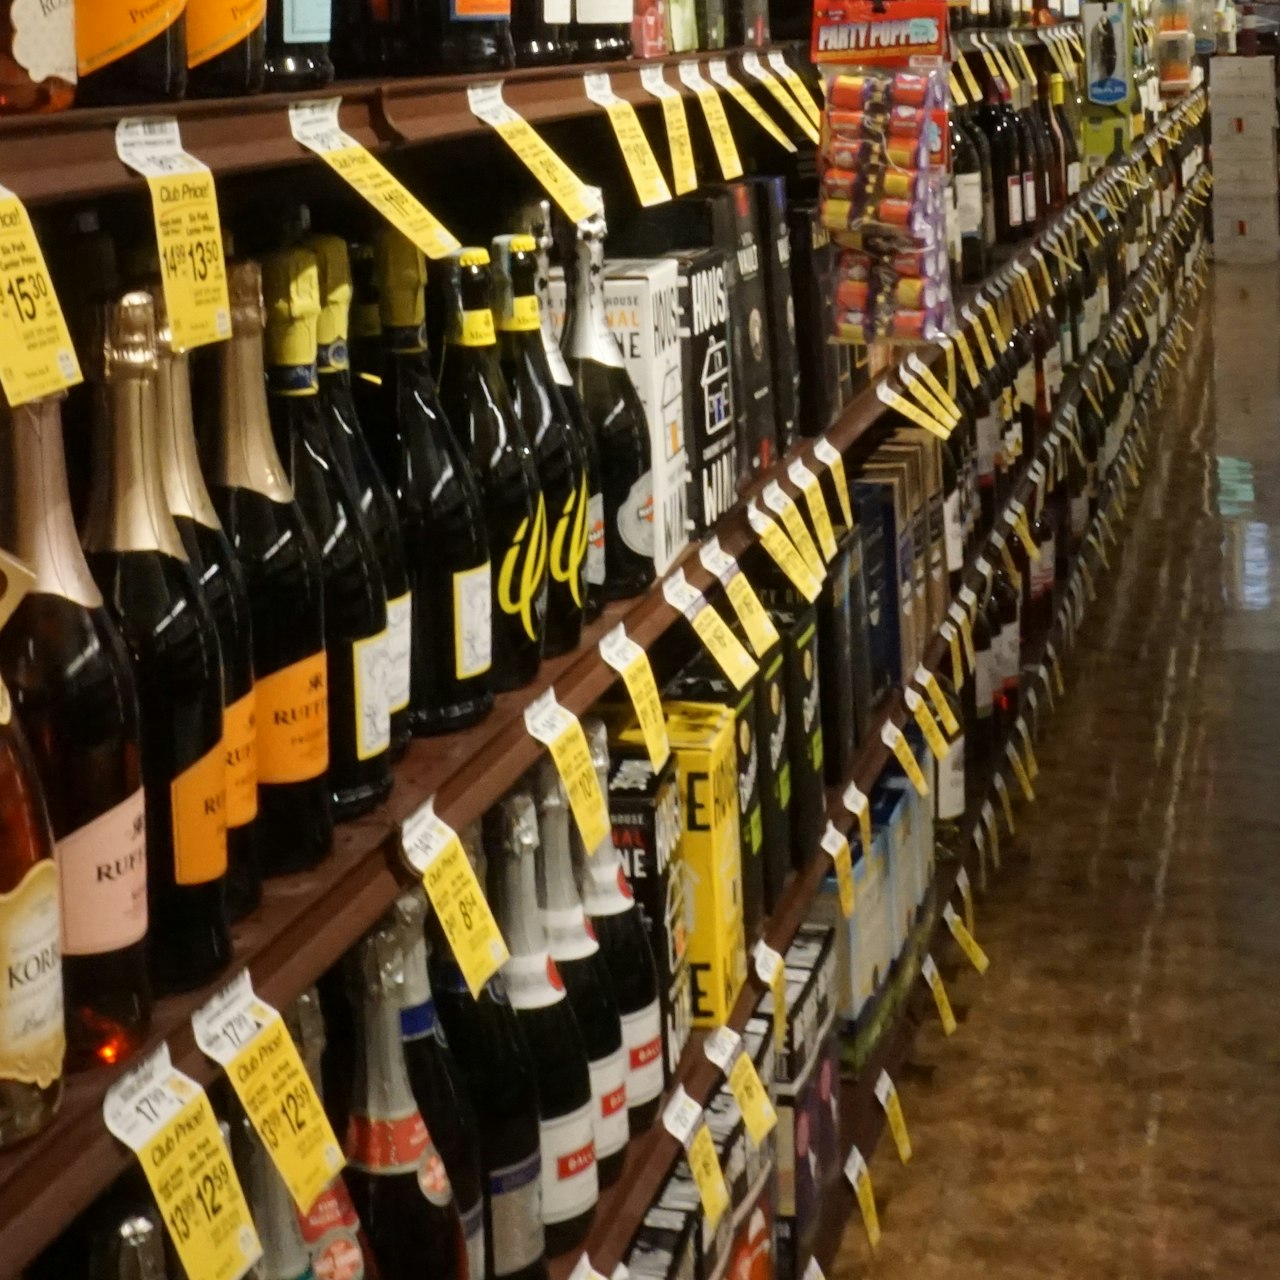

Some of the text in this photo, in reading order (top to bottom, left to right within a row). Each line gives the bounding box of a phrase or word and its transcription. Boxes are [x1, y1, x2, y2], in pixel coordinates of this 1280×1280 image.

[818, 22, 868, 51] PARTY
[159, 179, 211, 203] Club Price!
